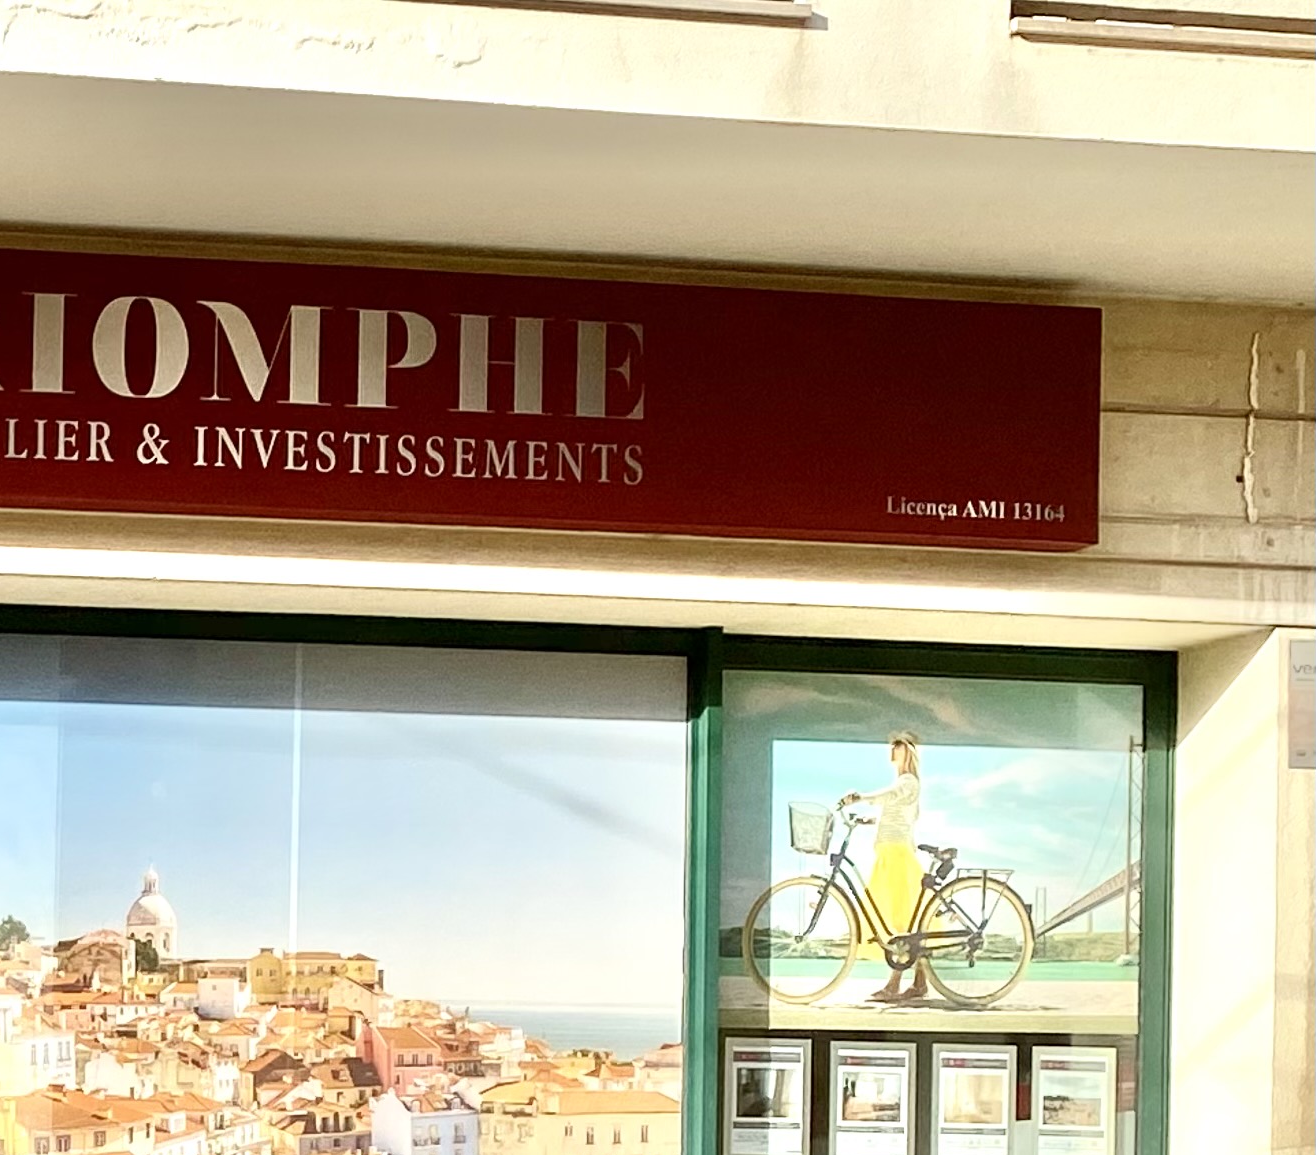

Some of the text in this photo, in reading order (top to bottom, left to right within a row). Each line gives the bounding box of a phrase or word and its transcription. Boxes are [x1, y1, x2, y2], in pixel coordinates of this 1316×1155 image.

[136, 423, 170, 466] &
[192, 425, 644, 487] INVESTISSEMENTS
[886, 495, 1066, 523] Licença AMI 13164
